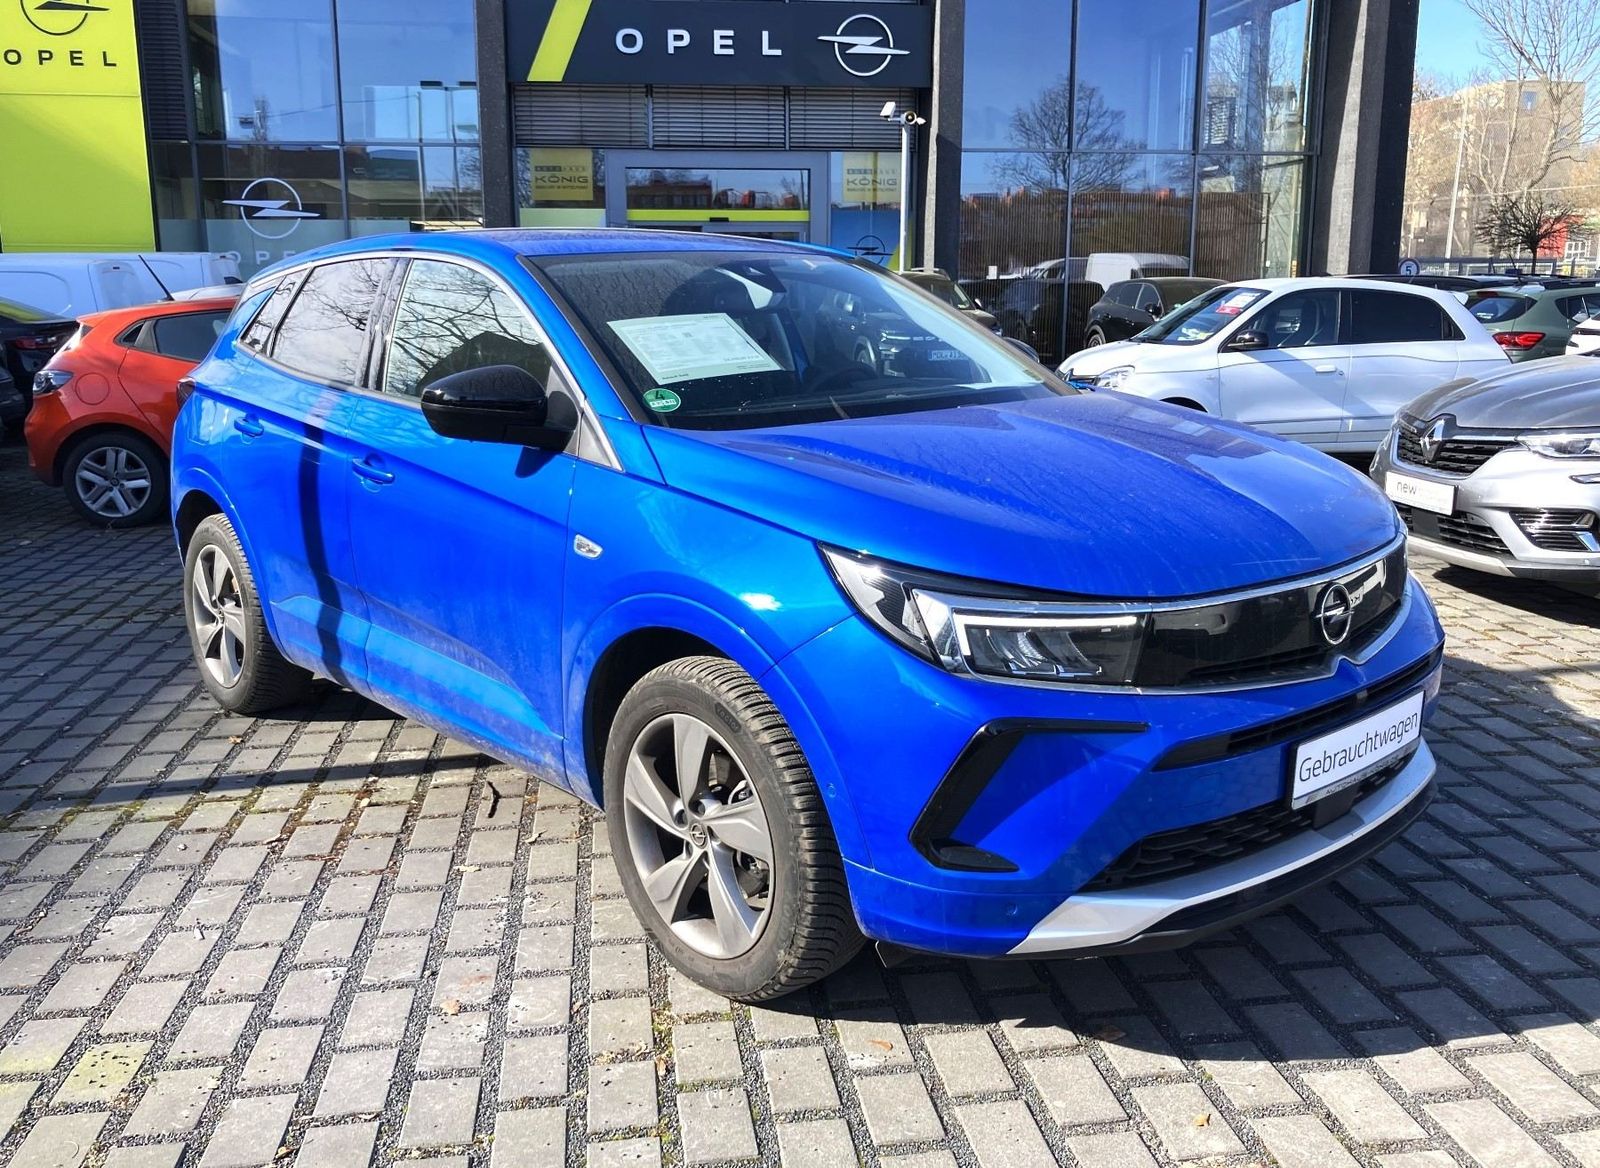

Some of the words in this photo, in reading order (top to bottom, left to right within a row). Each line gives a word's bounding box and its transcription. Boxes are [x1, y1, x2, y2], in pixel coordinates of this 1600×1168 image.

[615, 28, 782, 56] OPEL
[3, 49, 117, 67] OPEL
[534, 174, 589, 184] KÖNIG
[846, 176, 898, 186] KÖNIG
[655, 390, 665, 400] 4
[1396, 481, 1417, 495] new
[1299, 712, 1418, 782] Gebrauchtwagen
